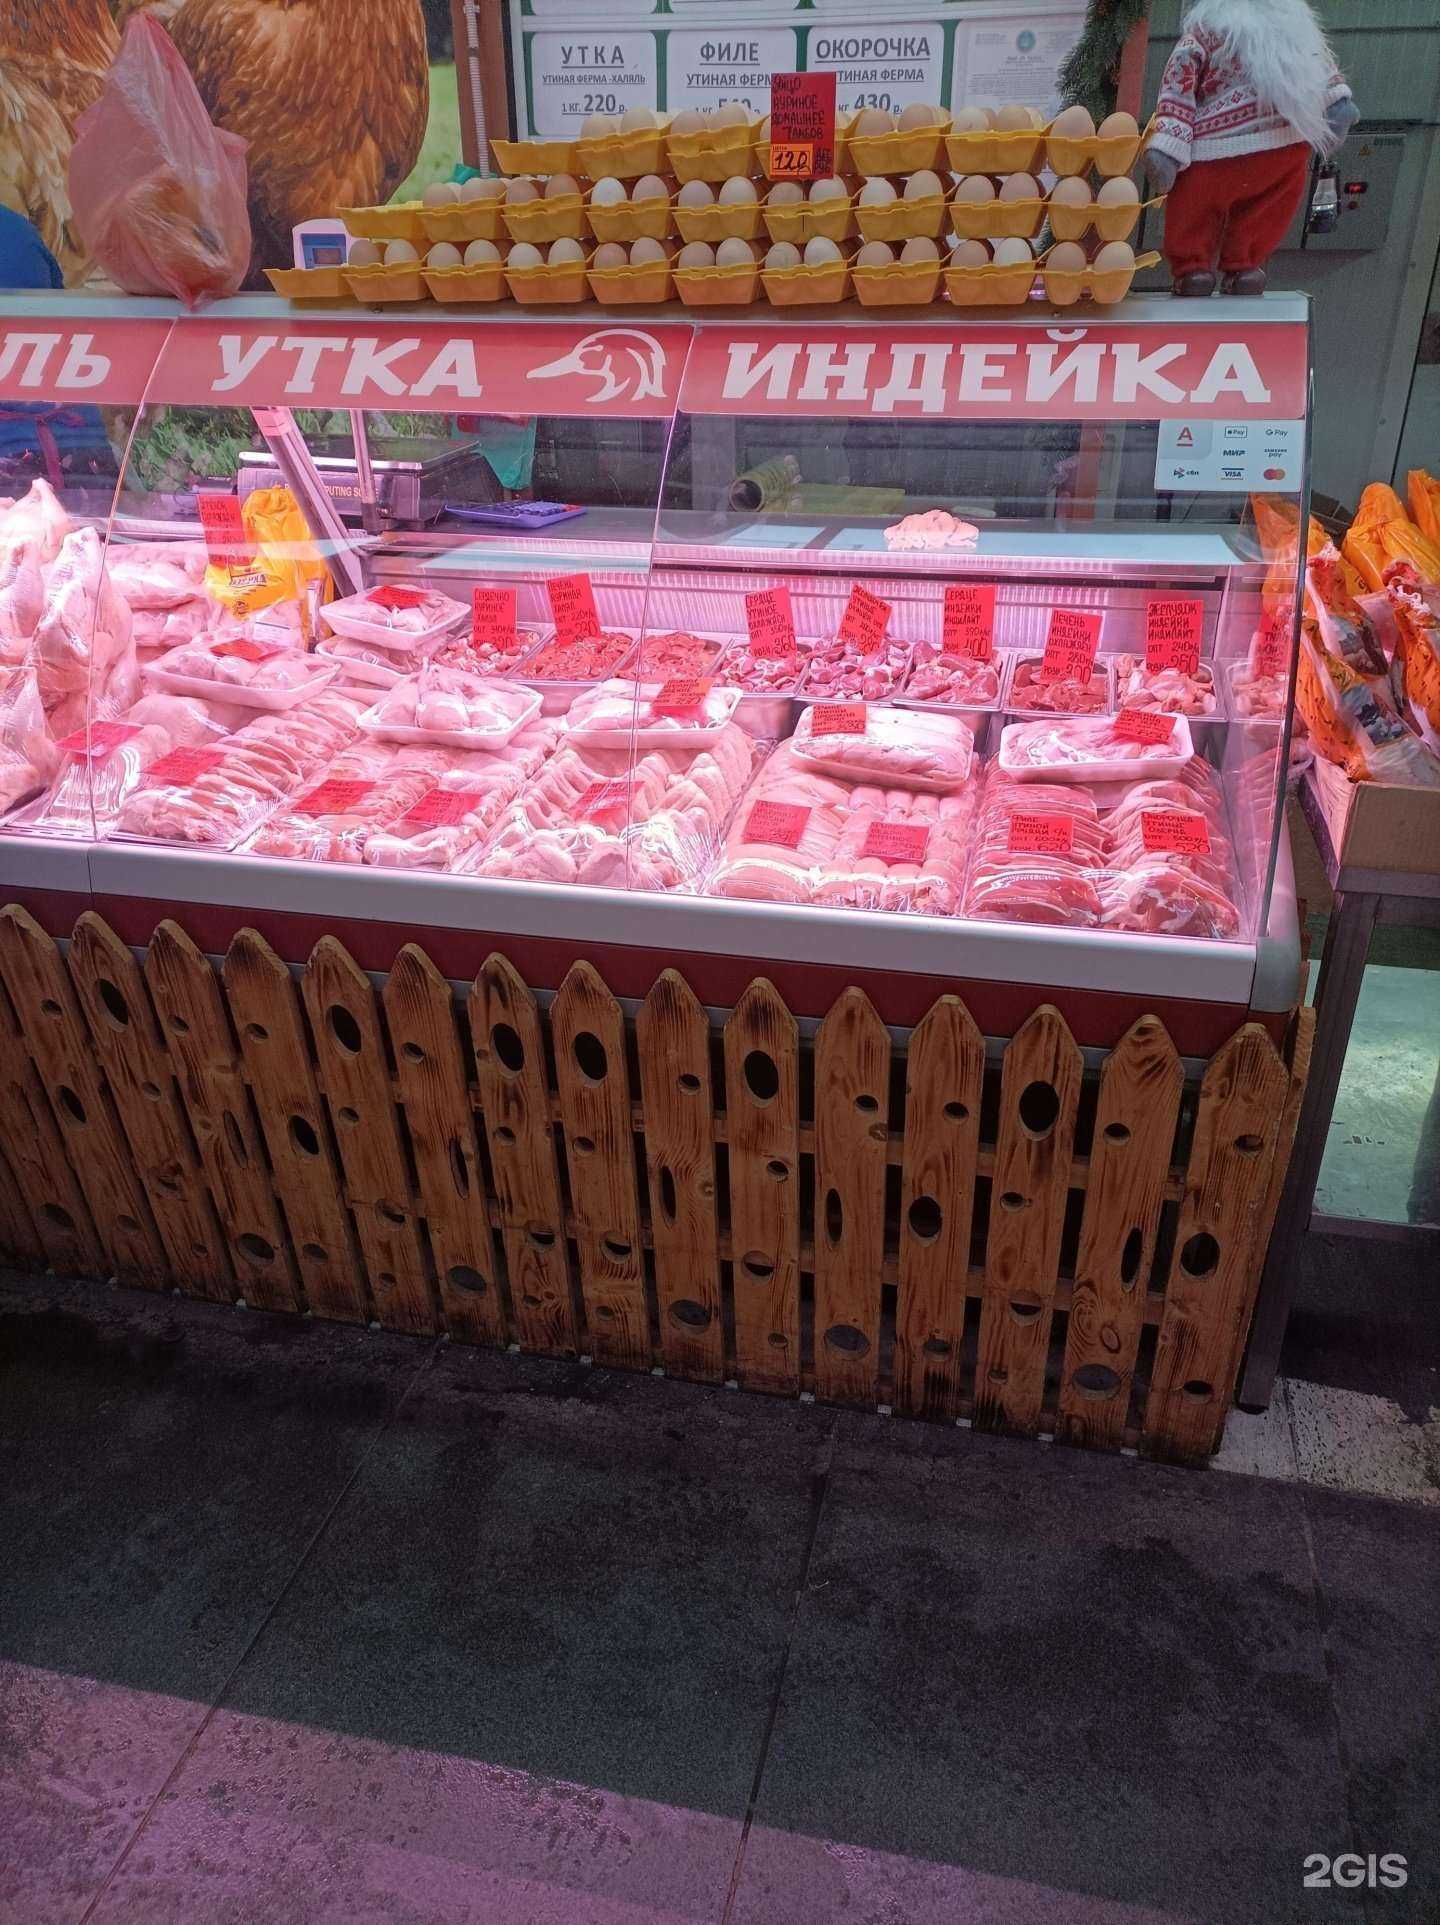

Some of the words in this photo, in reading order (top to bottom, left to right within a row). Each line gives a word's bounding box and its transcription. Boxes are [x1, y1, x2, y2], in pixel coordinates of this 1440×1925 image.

[561, 45, 625, 65] УТКА
[700, 41, 760, 62] ФИЛЕ
[816, 37, 931, 59] ОКОРОЧКА
[542, 74, 575, 84] УТИНАЯ
[577, 74, 607, 84] ФЕРМА
[686, 73, 736, 86] УТИНАЯ
[838, 69, 877, 82] ТИНАЯ
[881, 68, 925, 81] ФЕРМА
[584, 94, 616, 112] 220
[854, 94, 891, 112] 430
[211, 334, 483, 397] УТКА
[721, 328, 1271, 412] ИНДЕЙКА
[1054, 611, 1086, 628] ПЕЧЕНЬ
